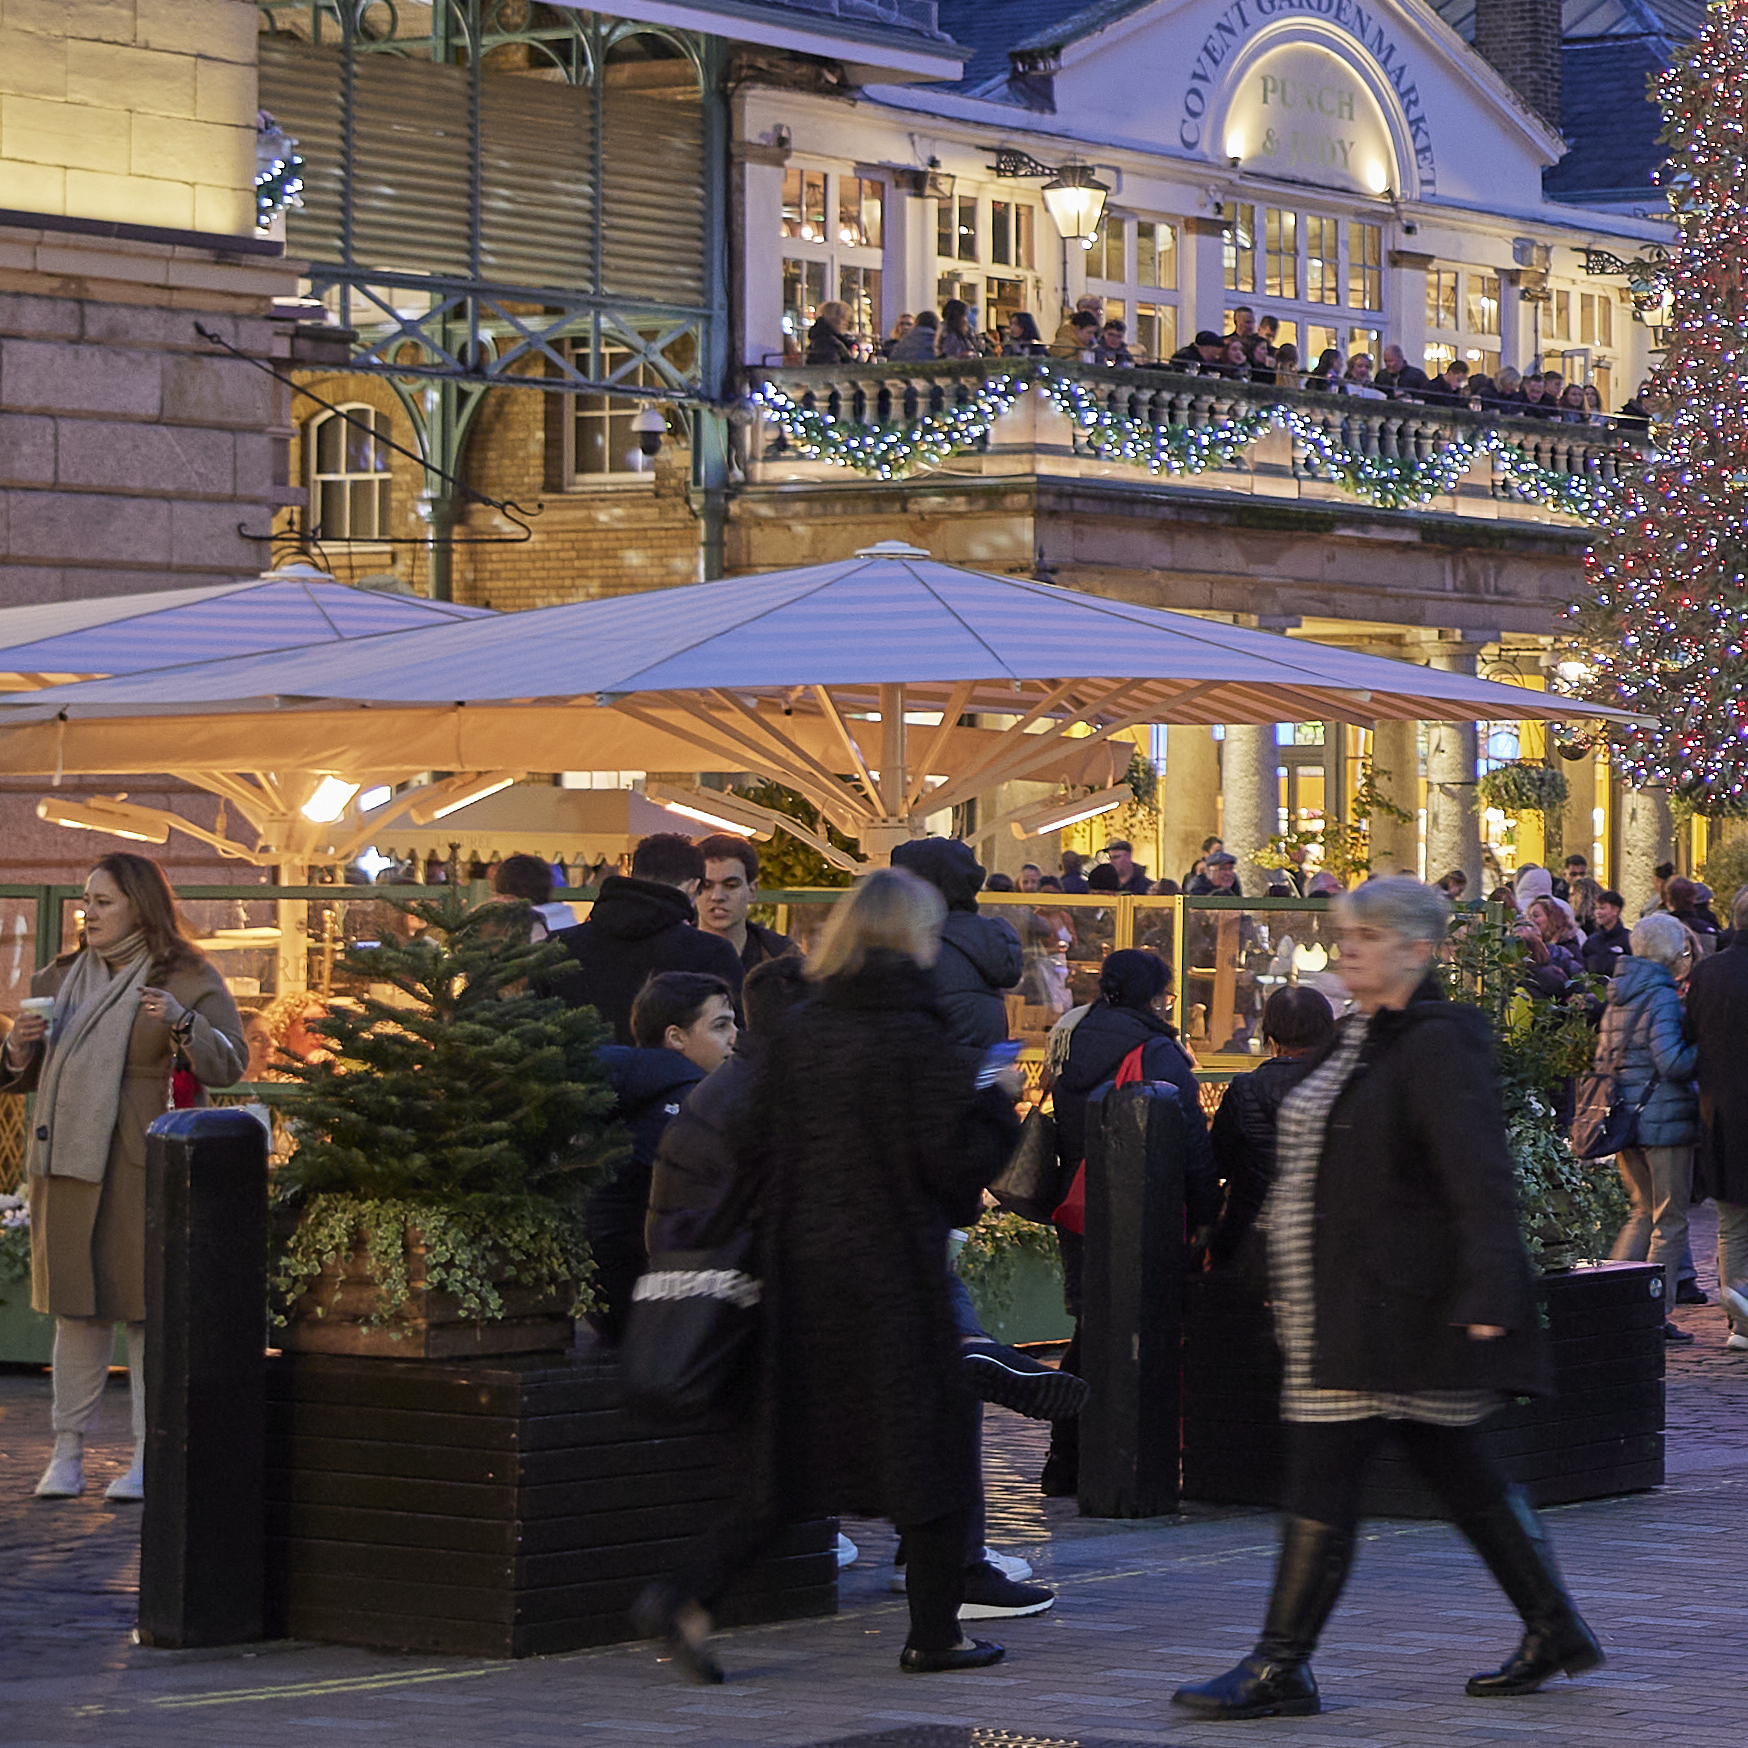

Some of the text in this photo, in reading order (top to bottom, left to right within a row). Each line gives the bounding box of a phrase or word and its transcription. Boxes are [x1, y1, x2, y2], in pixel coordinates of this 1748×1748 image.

[1261, 74, 1356, 122] PUNCH
[1369, 25, 1437, 197] MARKET
[1261, 128, 1356, 170] & JUDY
